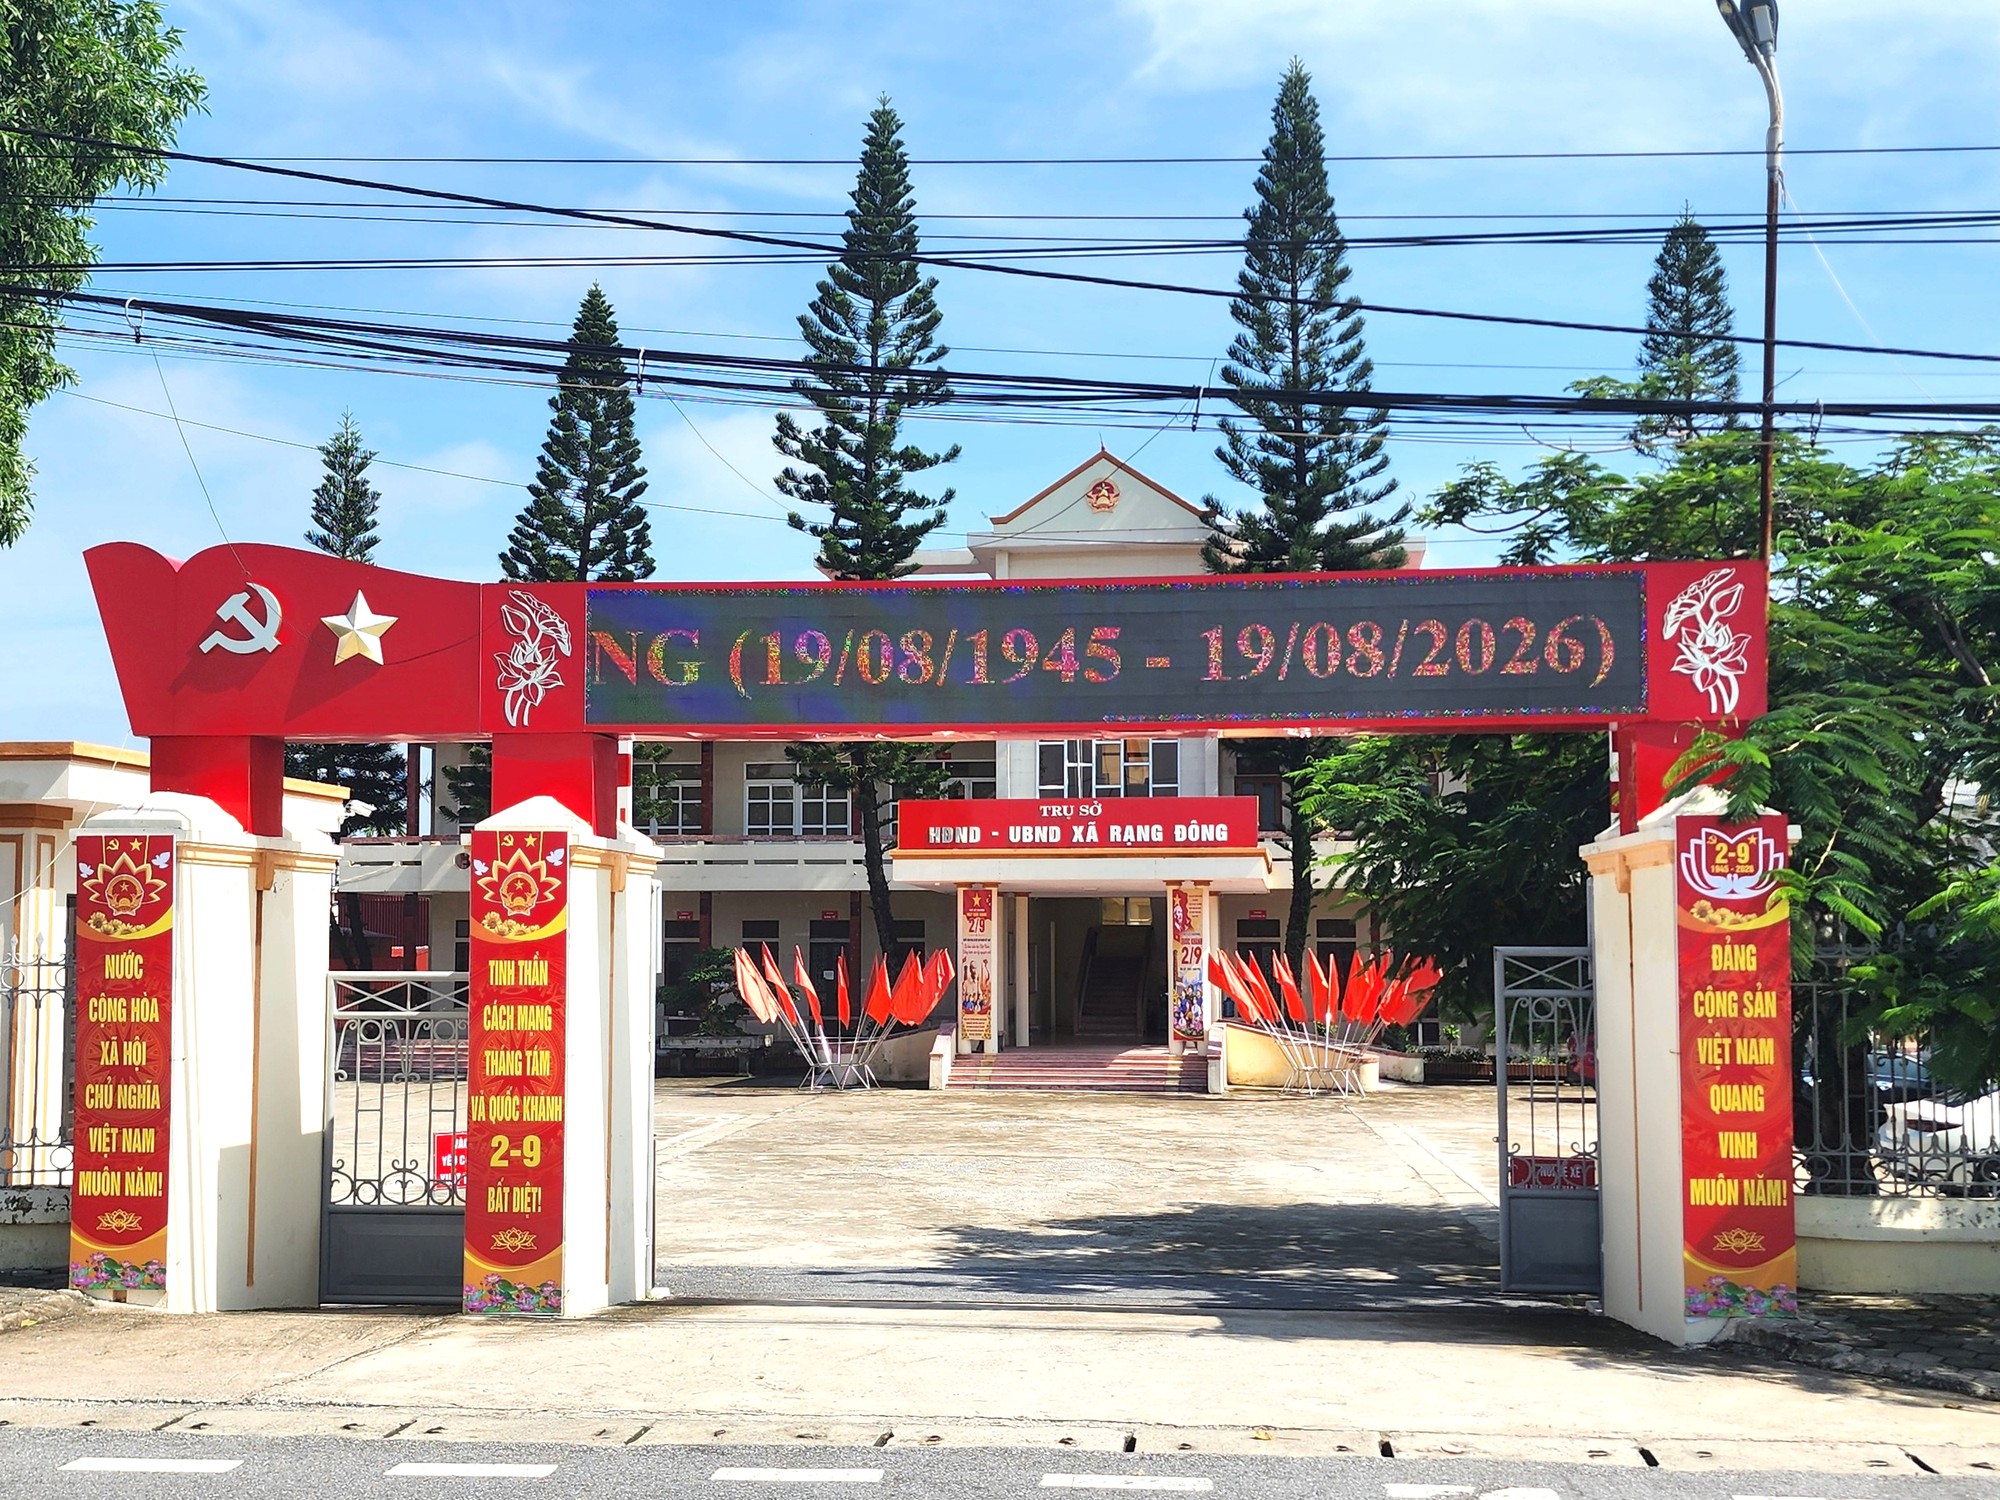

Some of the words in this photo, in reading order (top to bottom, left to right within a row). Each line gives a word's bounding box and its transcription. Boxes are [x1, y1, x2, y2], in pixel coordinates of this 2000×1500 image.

[591, 629, 706, 686] NG
[728, 627, 1121, 699] (19/08/1945
[1200, 614, 1616, 688] 19/08/2026)
[1040, 805, 1074, 820] TRỤ
[1079, 800, 1102, 816] SỞ
[1009, 825, 1061, 843] UBND
[1072, 821, 1099, 842] XÃ
[1109, 823, 1163, 846] RẠNG
[1174, 819, 1228, 842] ĐÔNG
[1715, 842, 1750, 864] 2-9
[968, 918, 985, 933] 2/9
[104, 950, 144, 979] NƯỚC
[488, 960, 515, 986] TINH
[518, 951, 548, 986] THẦN
[1181, 946, 1202, 965] 2/9
[1711, 935, 1757, 971] ĐẢNG
[88, 993, 127, 1028] CỘNG
[131, 992, 160, 1022] HÒA
[483, 1000, 514, 1031] CÁCH
[517, 1004, 552, 1036] MẠNG
[1693, 988, 1738, 1023] CỘNG
[1743, 982, 1777, 1018] SẢN
[100, 1036, 119, 1066] XÃ
[123, 1035, 147, 1071] HỘI
[484, 1045, 523, 1076] THÁNG
[525, 1045, 551, 1076] TÁM
[1697, 1033, 1732, 1070] VIỆT
[1736, 1037, 1774, 1065] NAM
[85, 1076, 114, 1109] CHỦ
[117, 1079, 161, 1109] NGHĨA
[471, 1090, 486, 1121] VÀ
[489, 1086, 520, 1124] QUỐC
[523, 1090, 562, 1121] KHÁNH
[1709, 1084, 1765, 1114] QUANG
[89, 1123, 119, 1158] VIỆT
[122, 1127, 155, 1153] NAM
[489, 1135, 542, 1168] 2-9
[1718, 1131, 1757, 1159] VINH
[79, 1166, 121, 1196] MUÔN
[125, 1166, 163, 1197] NĂM!
[487, 1177, 510, 1213] BẤT
[513, 1181, 542, 1219] DIỆT!
[1689, 1173, 1739, 1206] MUÔN
[1743, 1173, 1787, 1206] NĂM!
